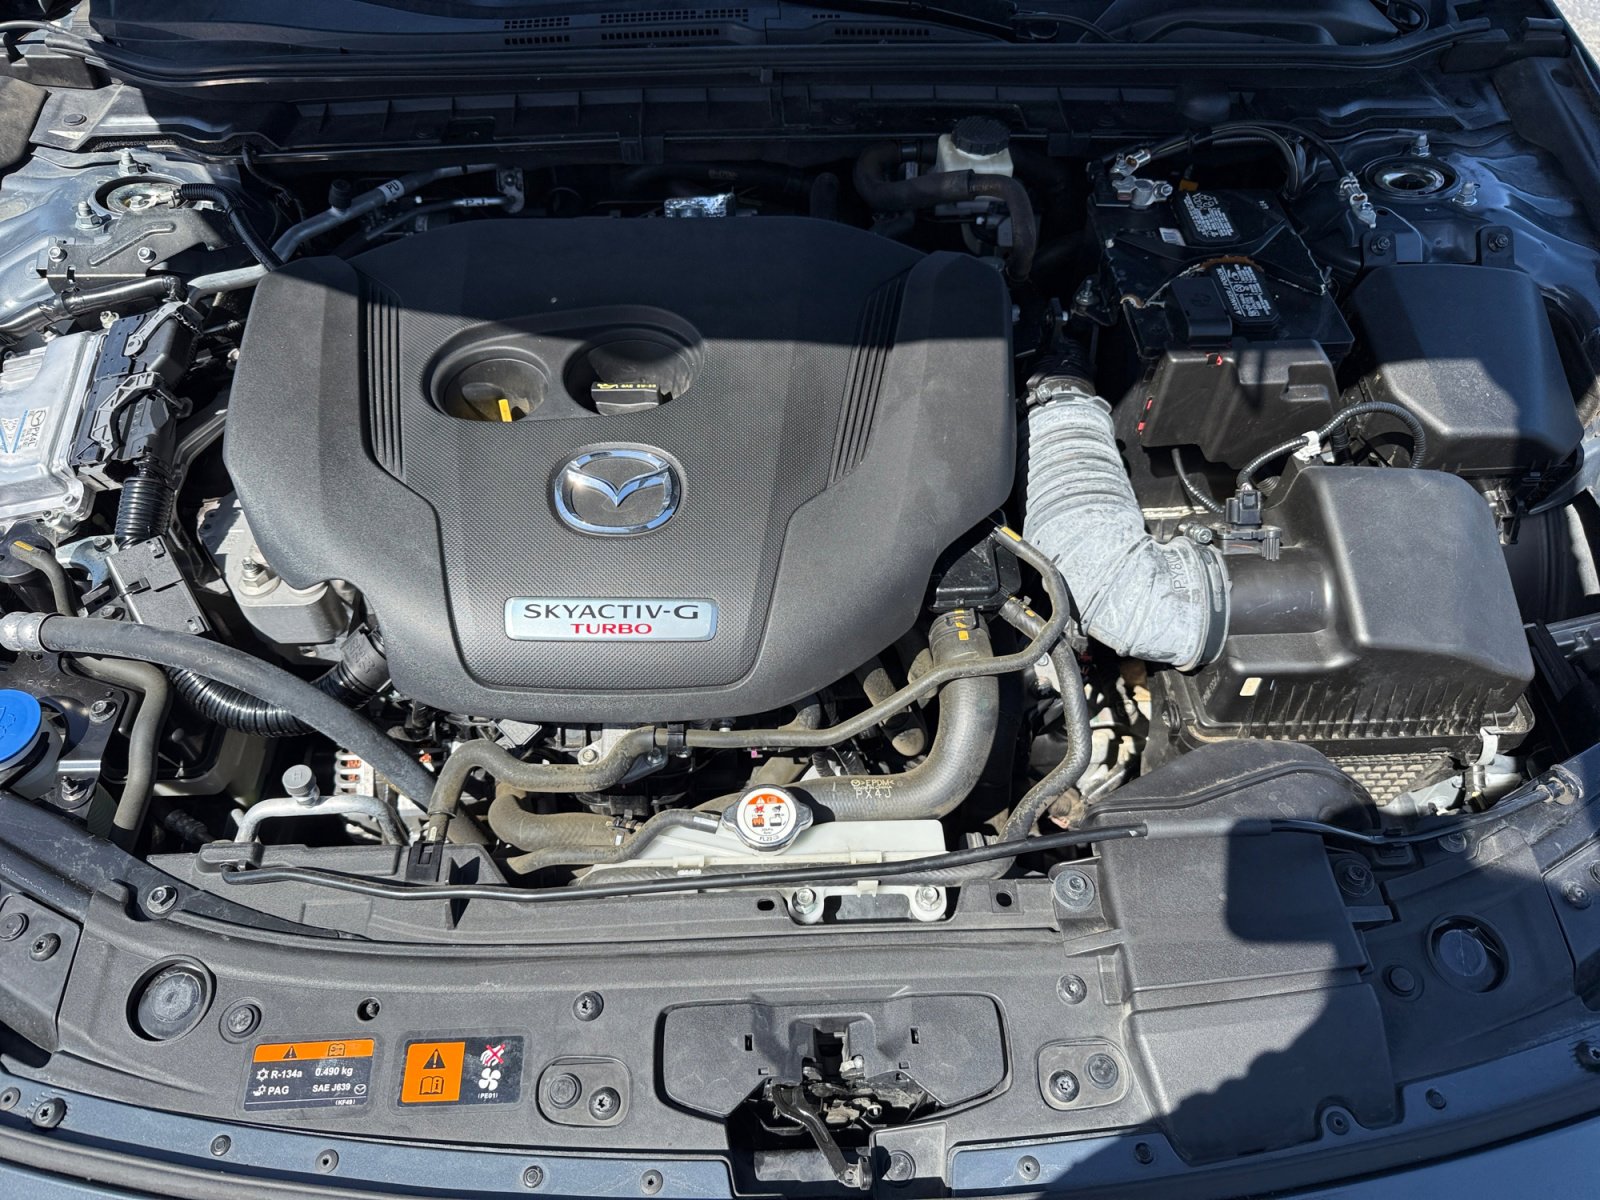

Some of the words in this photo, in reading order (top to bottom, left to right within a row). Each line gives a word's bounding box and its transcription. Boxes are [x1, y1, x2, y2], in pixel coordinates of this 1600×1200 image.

[386, 181, 400, 194] PU
[523, 603, 699, 620] SKYACTIV-G
[570, 623, 652, 635] TURBO
[855, 788, 892, 800] PX4J
[270, 1069, 303, 1080] R-134a
[314, 1067, 340, 1077] 0.490
[341, 1066, 354, 1077] kg
[267, 1085, 290, 1096] PAG
[312, 1084, 330, 1093] SAE
[331, 1083, 351, 1093] J639
